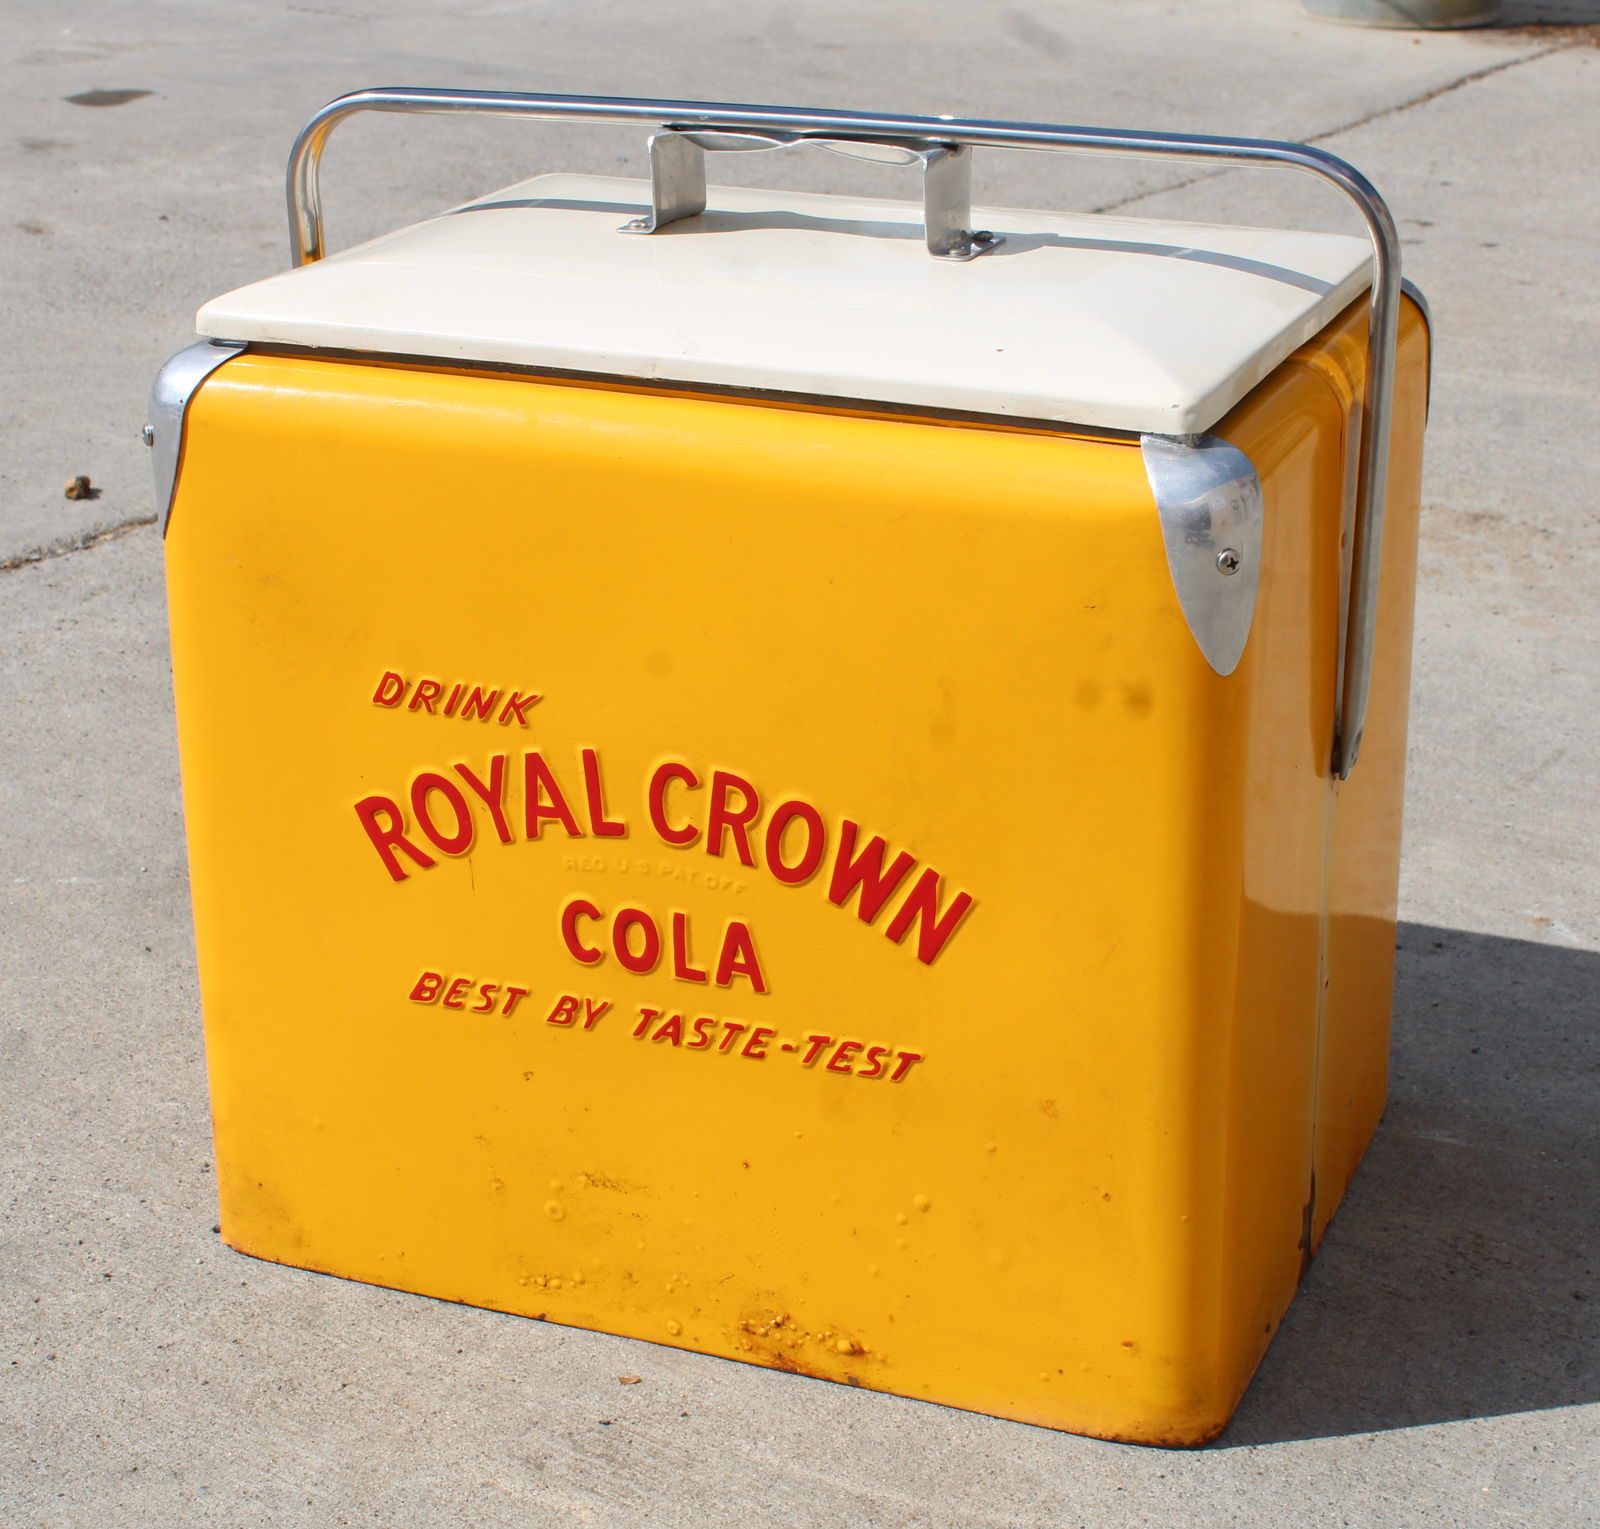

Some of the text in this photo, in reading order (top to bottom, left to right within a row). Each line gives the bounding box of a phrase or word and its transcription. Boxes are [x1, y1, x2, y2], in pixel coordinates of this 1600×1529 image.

[373, 671, 541, 726] DRINK
[354, 748, 972, 965] ROYAL CROWN
[561, 899, 766, 993] COLA
[409, 972, 922, 1082] BEST BY TASTE-TEST
